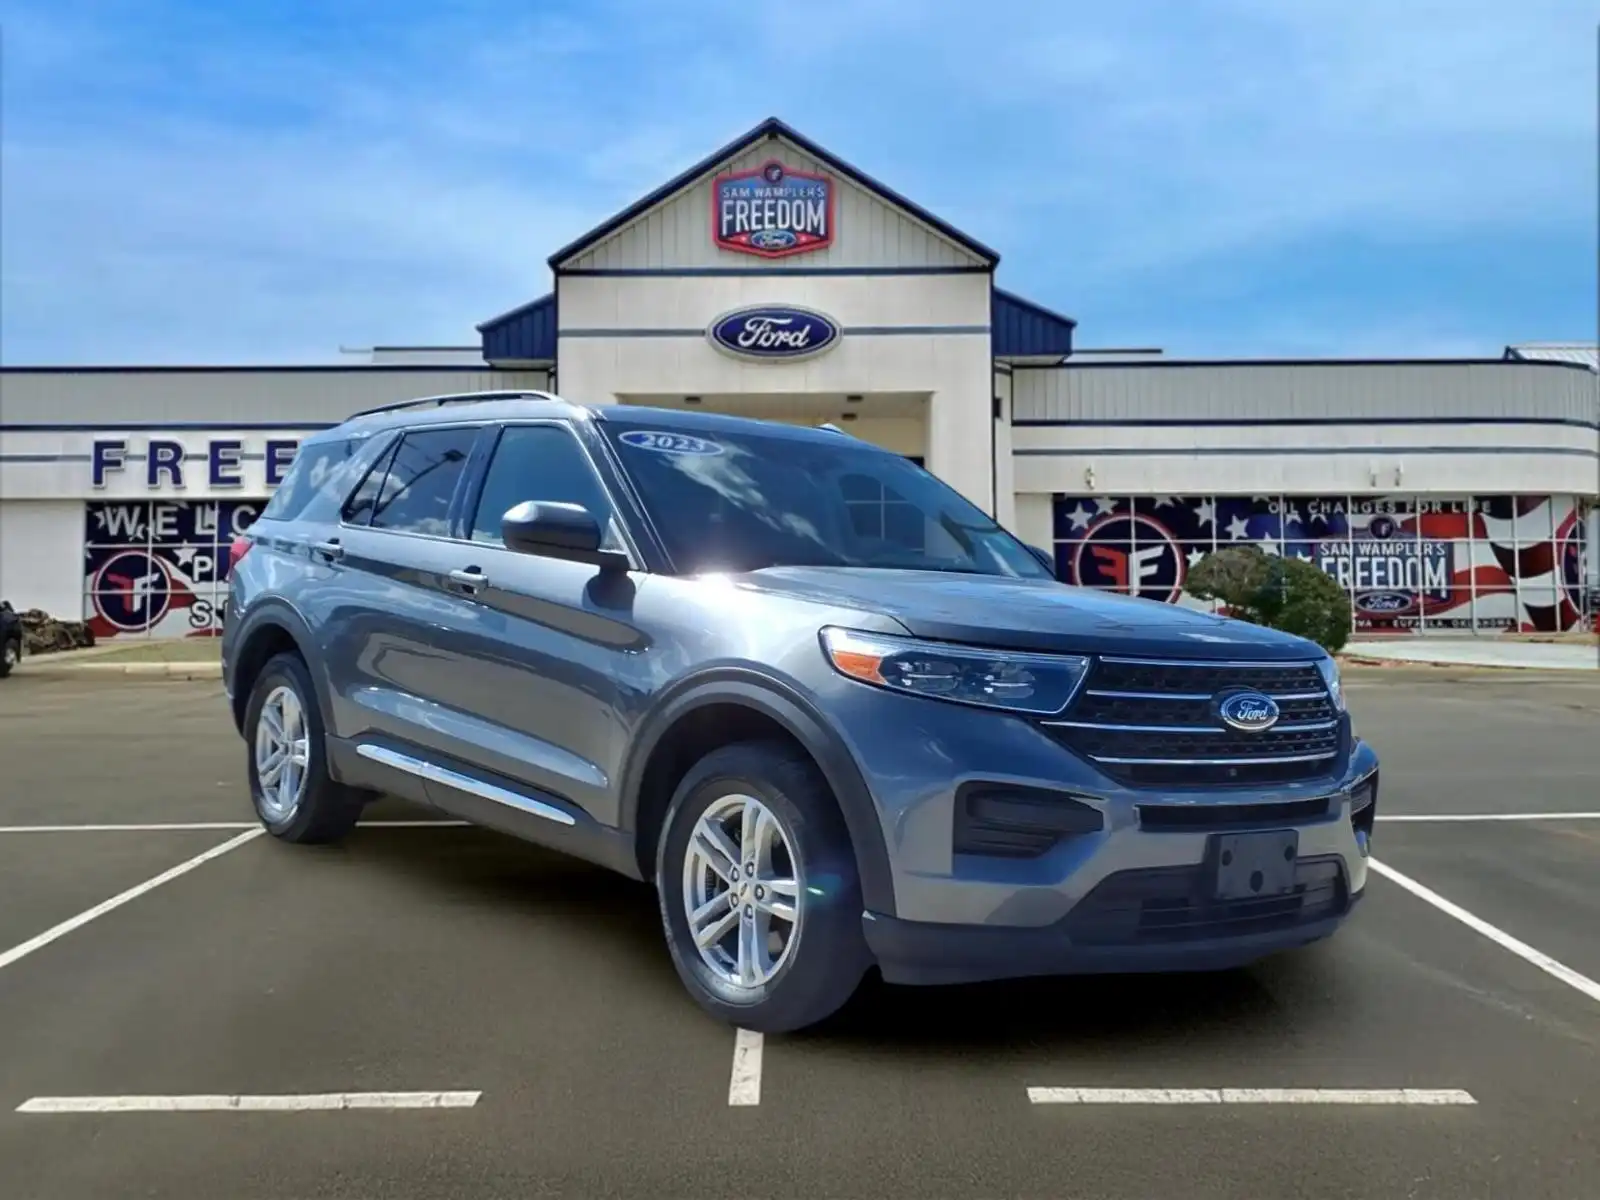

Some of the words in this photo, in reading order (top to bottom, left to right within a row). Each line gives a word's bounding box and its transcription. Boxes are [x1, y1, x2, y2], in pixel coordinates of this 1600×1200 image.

[723, 187, 750, 198] SAM
[722, 199, 825, 236] FREEDOM
[738, 316, 811, 347] Ford
[641, 435, 705, 452] 2023
[1267, 501, 1299, 514] OIL
[1307, 501, 1396, 514] CHANGES
[1406, 500, 1442, 513] FOR
[1321, 556, 1447, 599] FREEDOM
[1237, 700, 1269, 721] Ford
